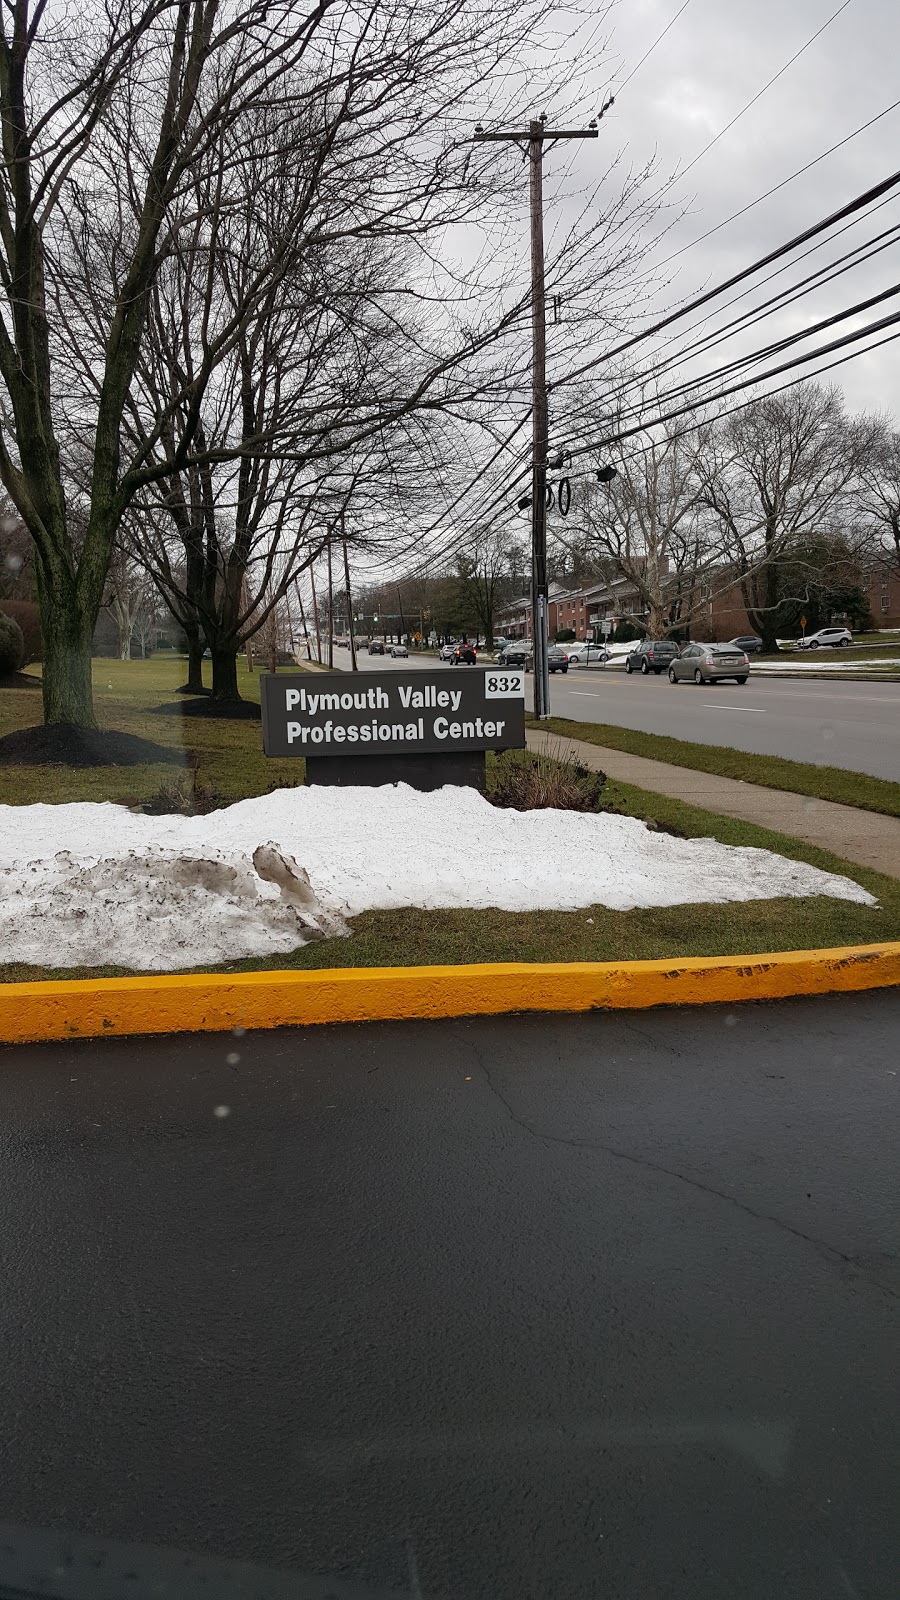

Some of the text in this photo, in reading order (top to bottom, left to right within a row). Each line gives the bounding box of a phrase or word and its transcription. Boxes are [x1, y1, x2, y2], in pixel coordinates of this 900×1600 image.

[487, 677, 521, 692] 832
[285, 685, 462, 715] Plymouth Valley
[287, 717, 506, 744] Professional Center
